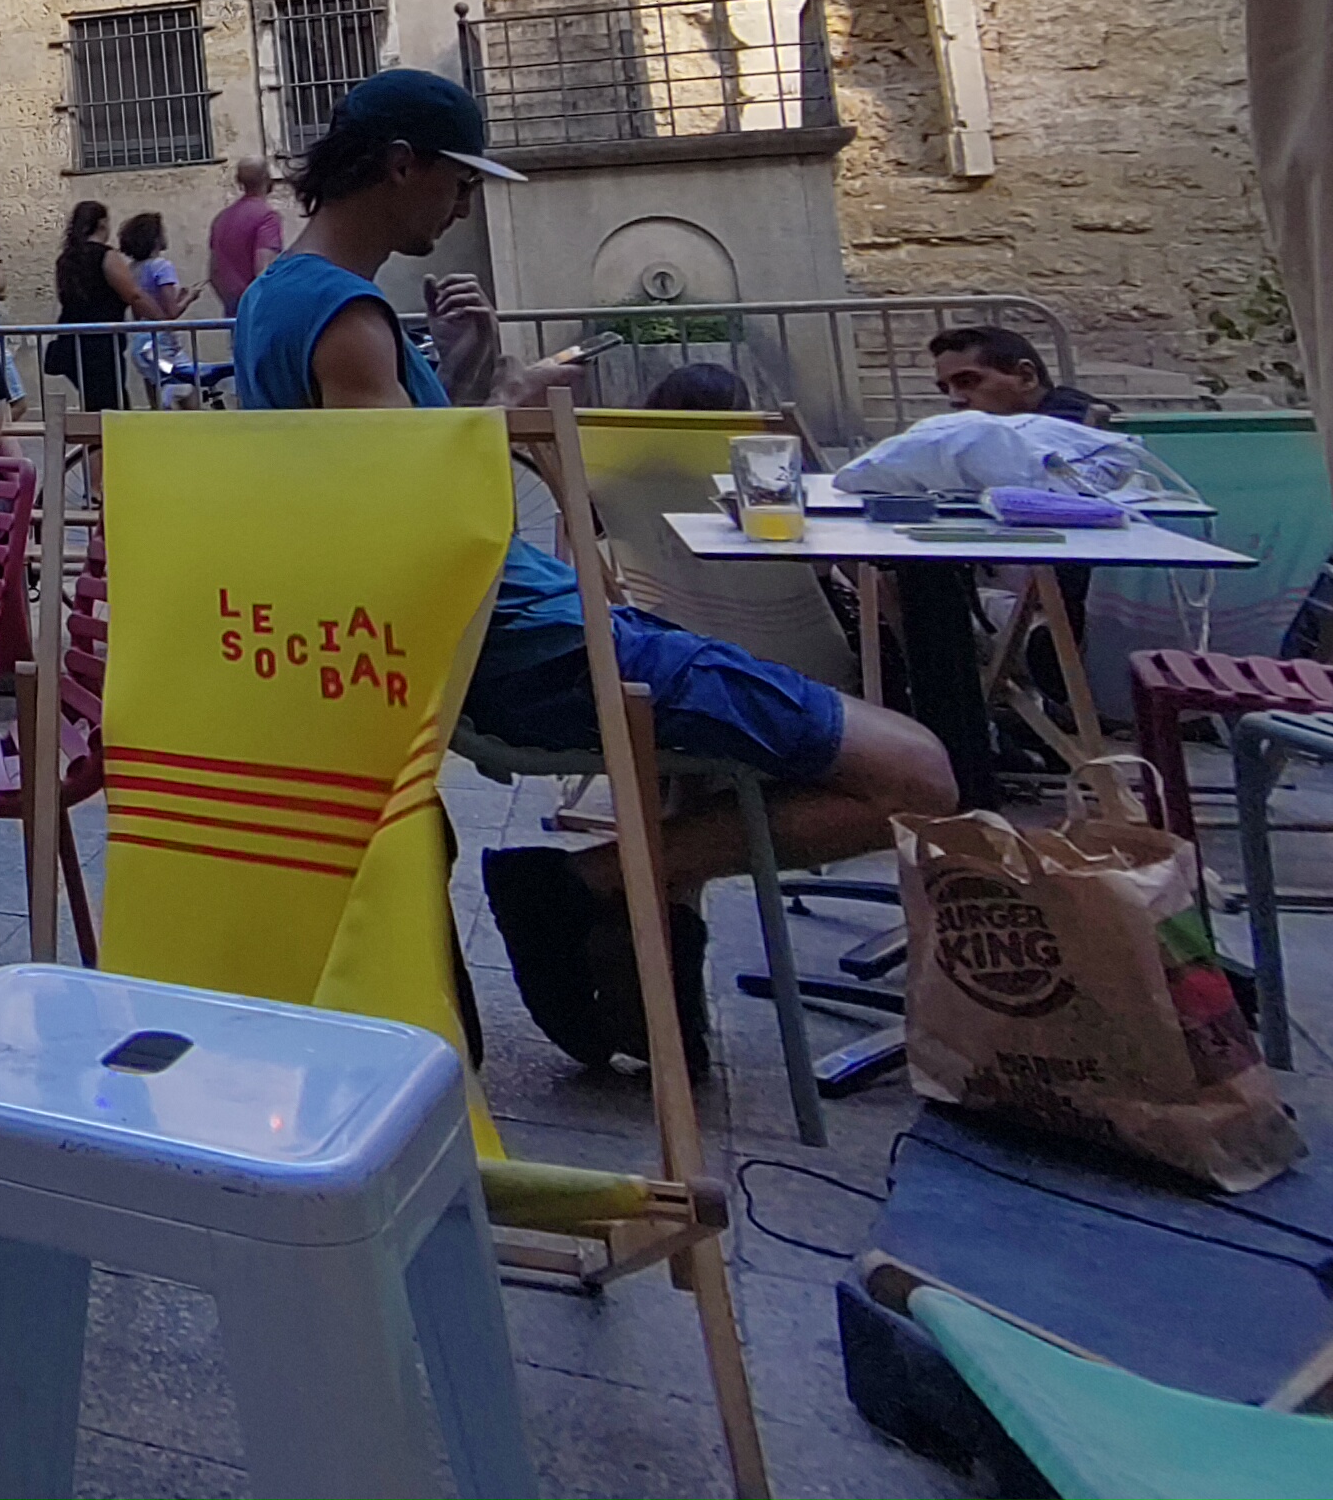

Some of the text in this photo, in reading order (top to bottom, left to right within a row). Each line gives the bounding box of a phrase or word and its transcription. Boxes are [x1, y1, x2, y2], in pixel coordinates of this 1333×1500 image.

[219, 588, 274, 634] LE
[221, 606, 407, 680] SOCIAL
[320, 652, 409, 708] BAR
[939, 930, 1062, 972] KING
